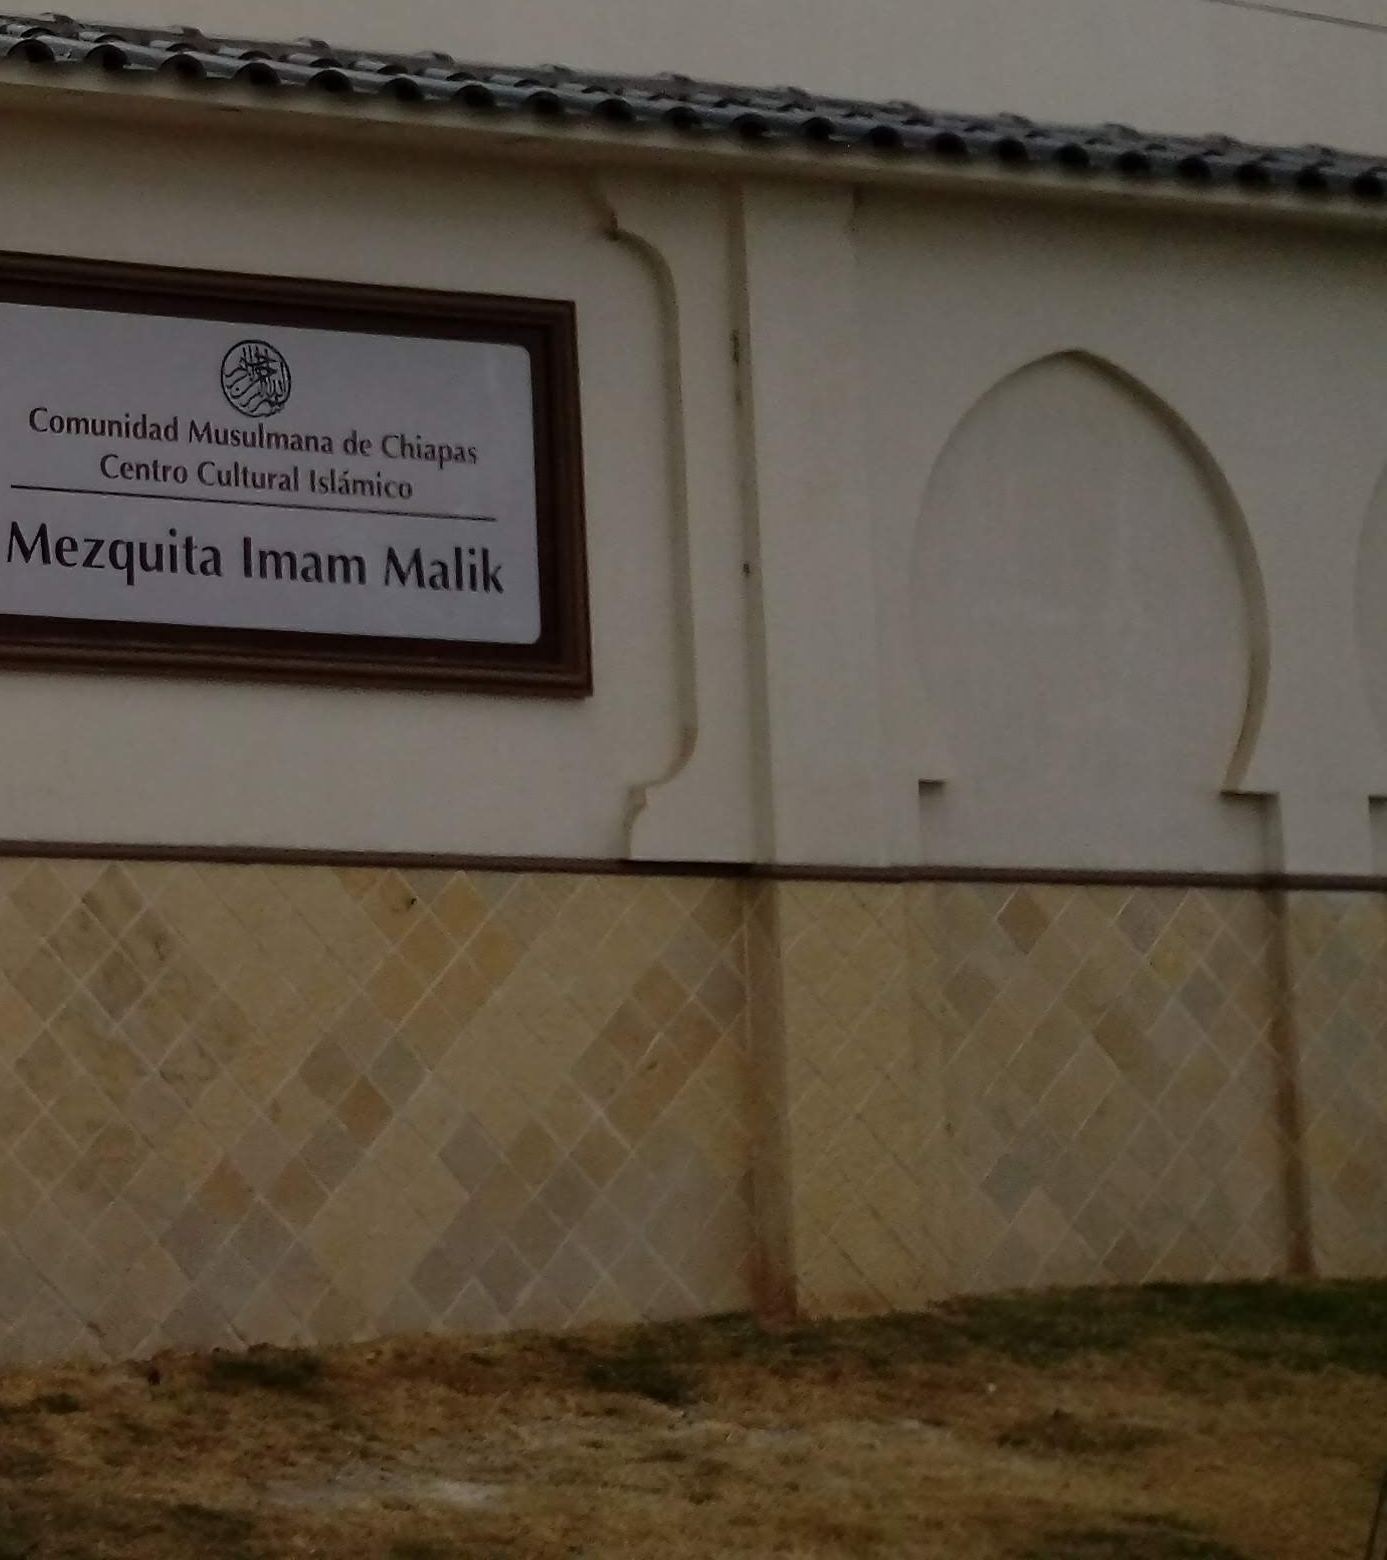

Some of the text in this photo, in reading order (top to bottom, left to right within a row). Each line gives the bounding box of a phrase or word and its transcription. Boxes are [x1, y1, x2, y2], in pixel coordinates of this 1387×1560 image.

[28, 406, 479, 468] Comunidad Musulmana de Chiapas
[99, 453, 414, 501] Centro Cultural Islámico
[6, 520, 505, 594] Mezquita Imam Malik
